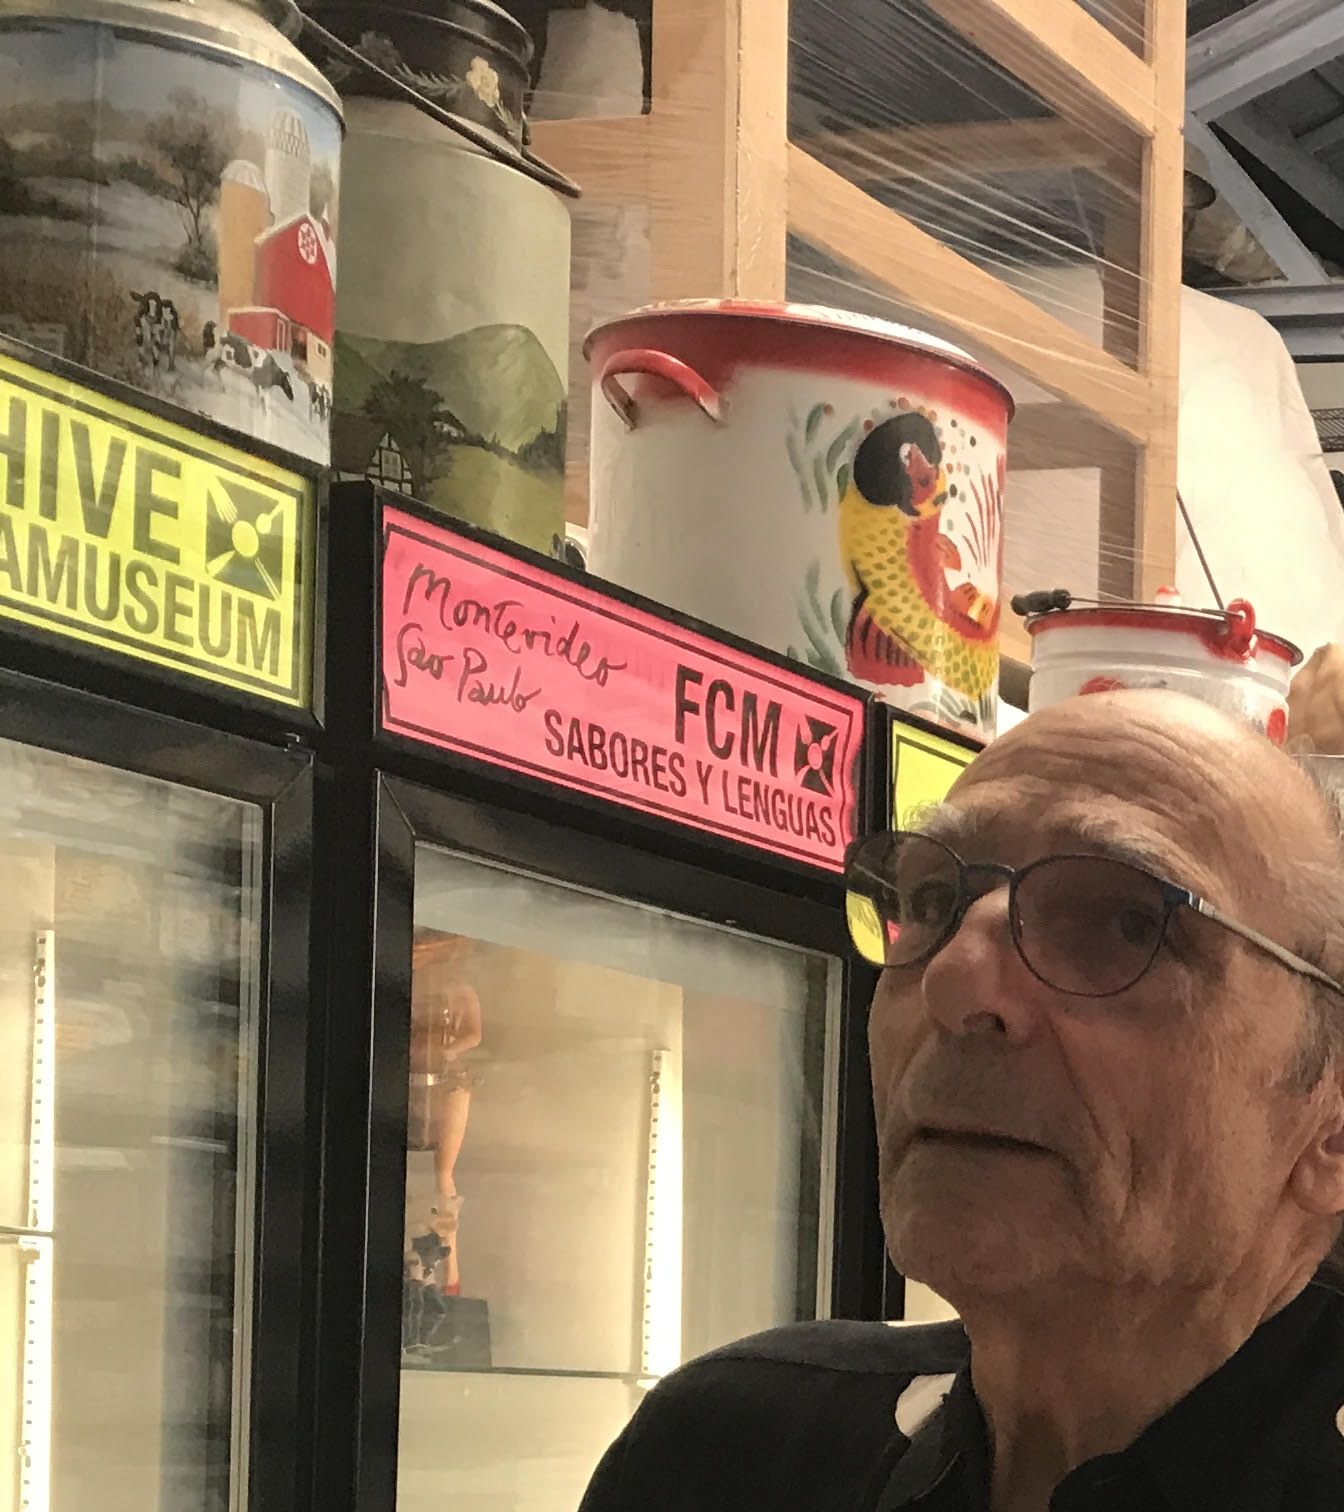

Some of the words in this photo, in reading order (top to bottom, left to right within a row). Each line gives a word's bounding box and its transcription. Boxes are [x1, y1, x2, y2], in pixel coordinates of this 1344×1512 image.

[403, 563, 627, 686] Montevideo
[457, 648, 542, 713] Paulo
[544, 709, 686, 797] SABORES
[696, 760, 713, 805] Y
[722, 769, 836, 847] LENGUAS
[675, 663, 782, 777] FCM
